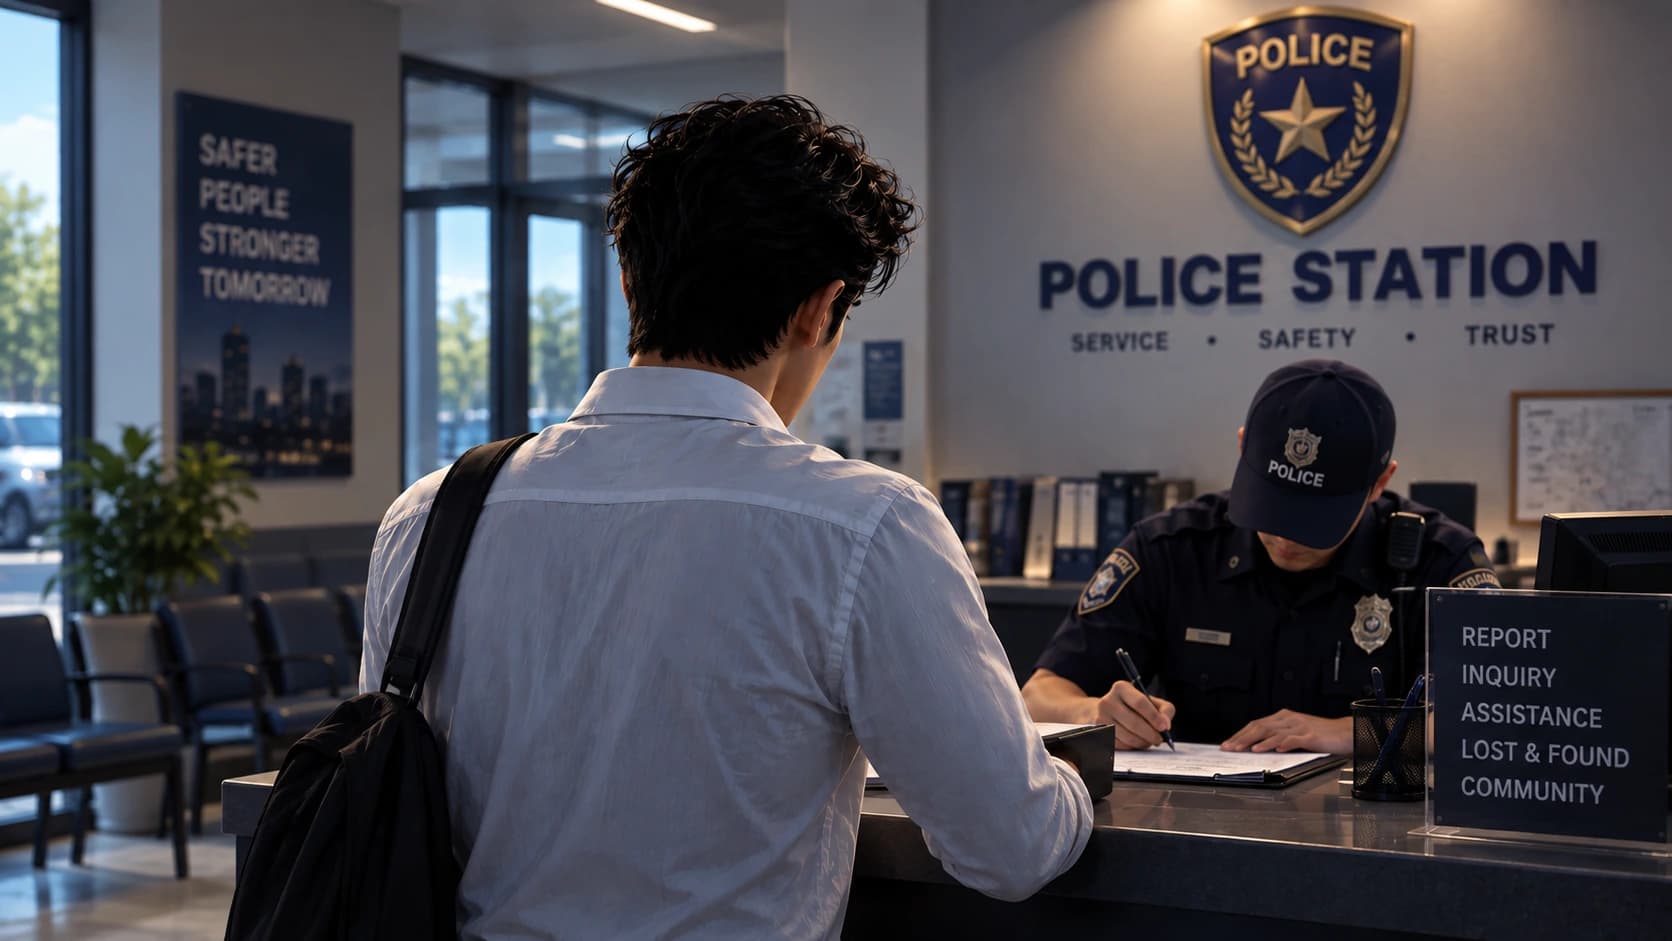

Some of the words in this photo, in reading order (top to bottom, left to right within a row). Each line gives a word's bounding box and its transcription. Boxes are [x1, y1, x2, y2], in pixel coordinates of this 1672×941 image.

[1235, 32, 1375, 79] POLICE
[199, 133, 278, 176] SAFER
[199, 177, 290, 219] PEOPLE
[199, 223, 320, 265] STRONGER
[199, 266, 332, 308] TOMORROW
[1039, 252, 1262, 310] POLICE
[1293, 240, 1598, 303] STATION
[1071, 331, 1169, 353] SERVICE
[1259, 327, 1356, 350] SAFETY
[1466, 323, 1555, 346] TRUST
[1268, 459, 1325, 488] POLICE
[1462, 626, 1552, 649] REPORT
[1462, 664, 1557, 688] INQUIRY
[1461, 702, 1603, 729] ASSISTANCE
[1461, 739, 1518, 762] LOST
[1524, 743, 1541, 764] &
[1548, 744, 1630, 769] FOUND
[1461, 776, 1605, 805] COMMUNITY
